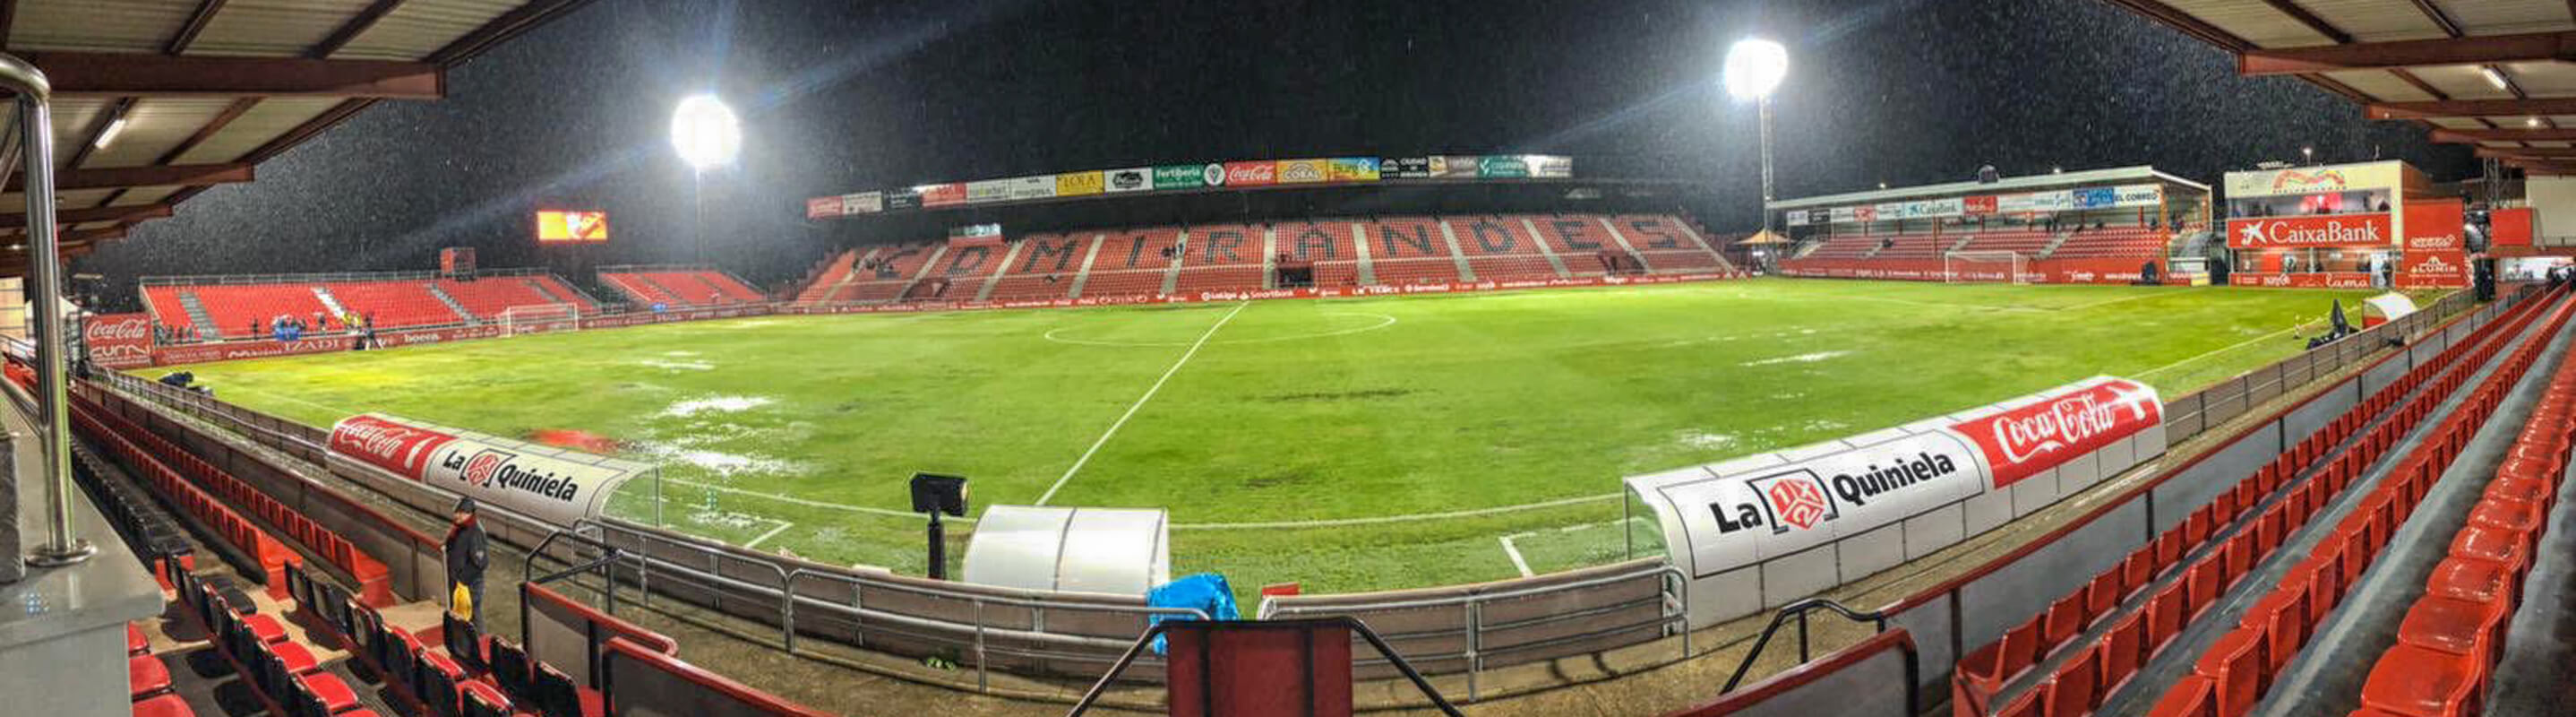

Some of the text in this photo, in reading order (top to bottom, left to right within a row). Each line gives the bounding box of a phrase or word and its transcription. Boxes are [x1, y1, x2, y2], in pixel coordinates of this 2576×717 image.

[2269, 220, 2380, 244] CaixaBank
[1993, 392, 2115, 464] Coca-Cola
[442, 450, 466, 471] La
[497, 463, 579, 502] Quiniela
[1709, 502, 1763, 534] La
[1832, 452, 1956, 505] Quiniela
